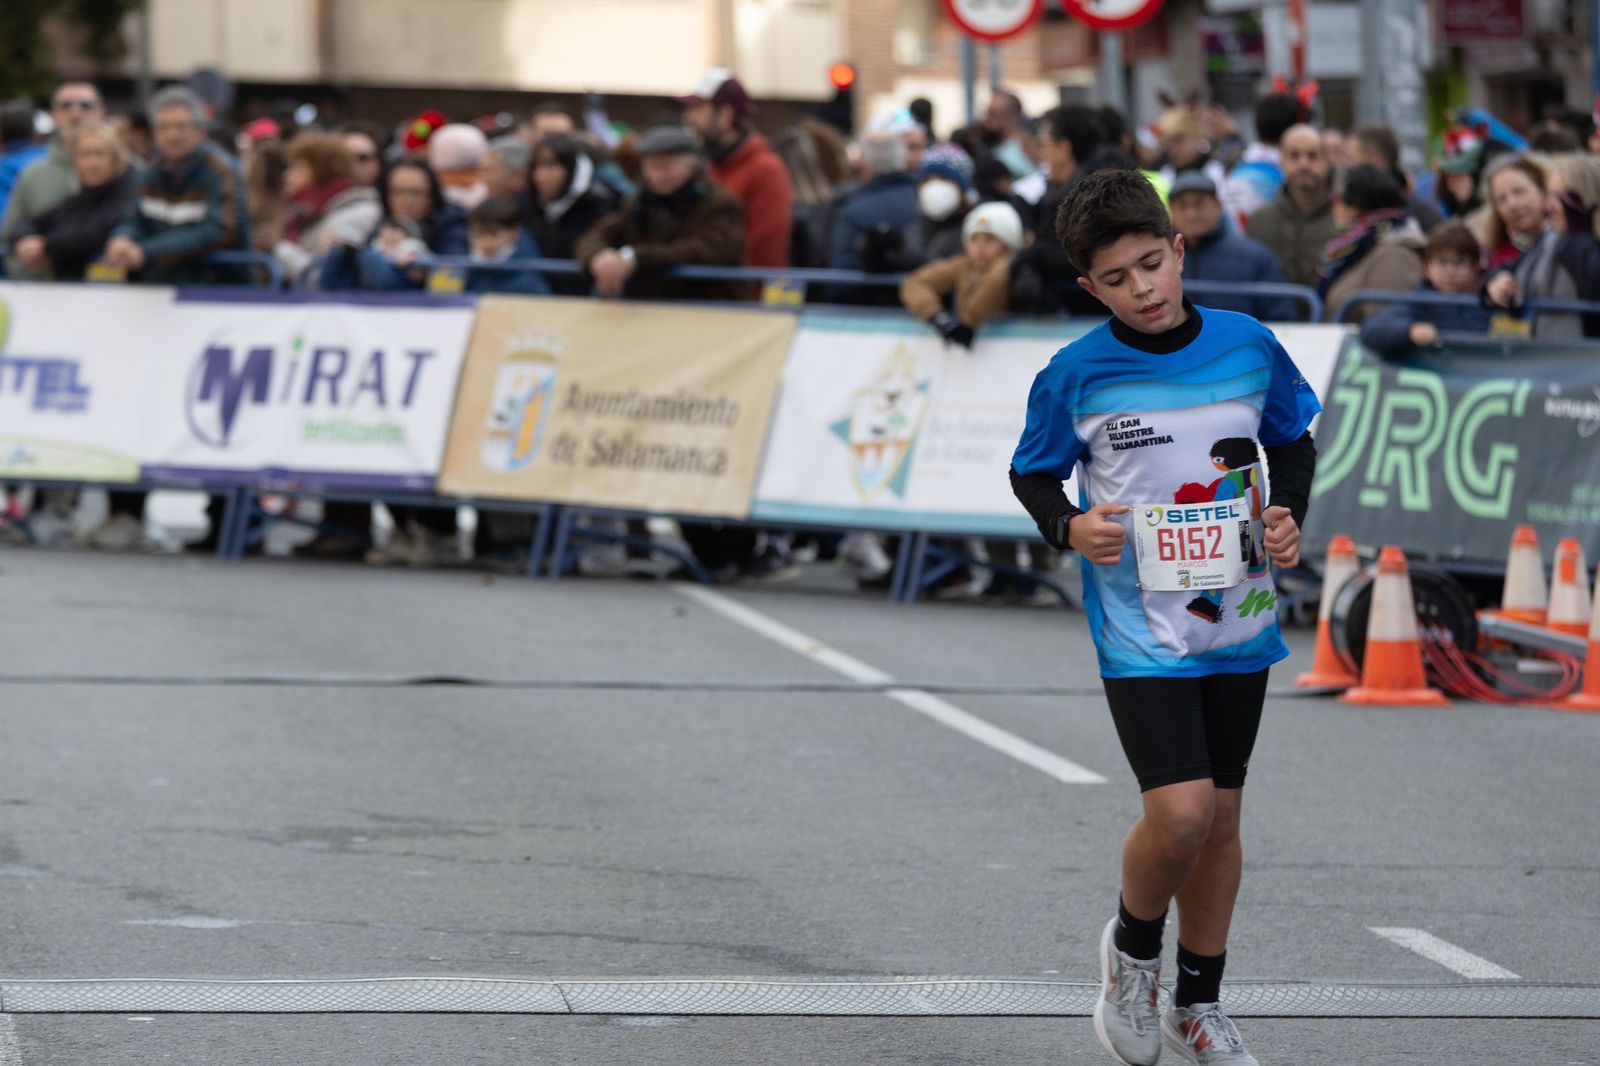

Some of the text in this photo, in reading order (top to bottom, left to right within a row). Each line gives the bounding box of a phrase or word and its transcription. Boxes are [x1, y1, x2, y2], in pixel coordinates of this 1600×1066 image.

[0, 356, 90, 395] TEL
[562, 382, 740, 427] Ayuntamiento
[1120, 418, 1141, 429] SAN
[1108, 427, 1154, 441] SILVESTRE
[1111, 435, 1174, 451] SALMANTINA
[550, 429, 729, 476] de Salamanca
[1167, 505, 1239, 523] SETEL
[1157, 525, 1224, 561] 6152
[1177, 560, 1208, 568] MARCOS
